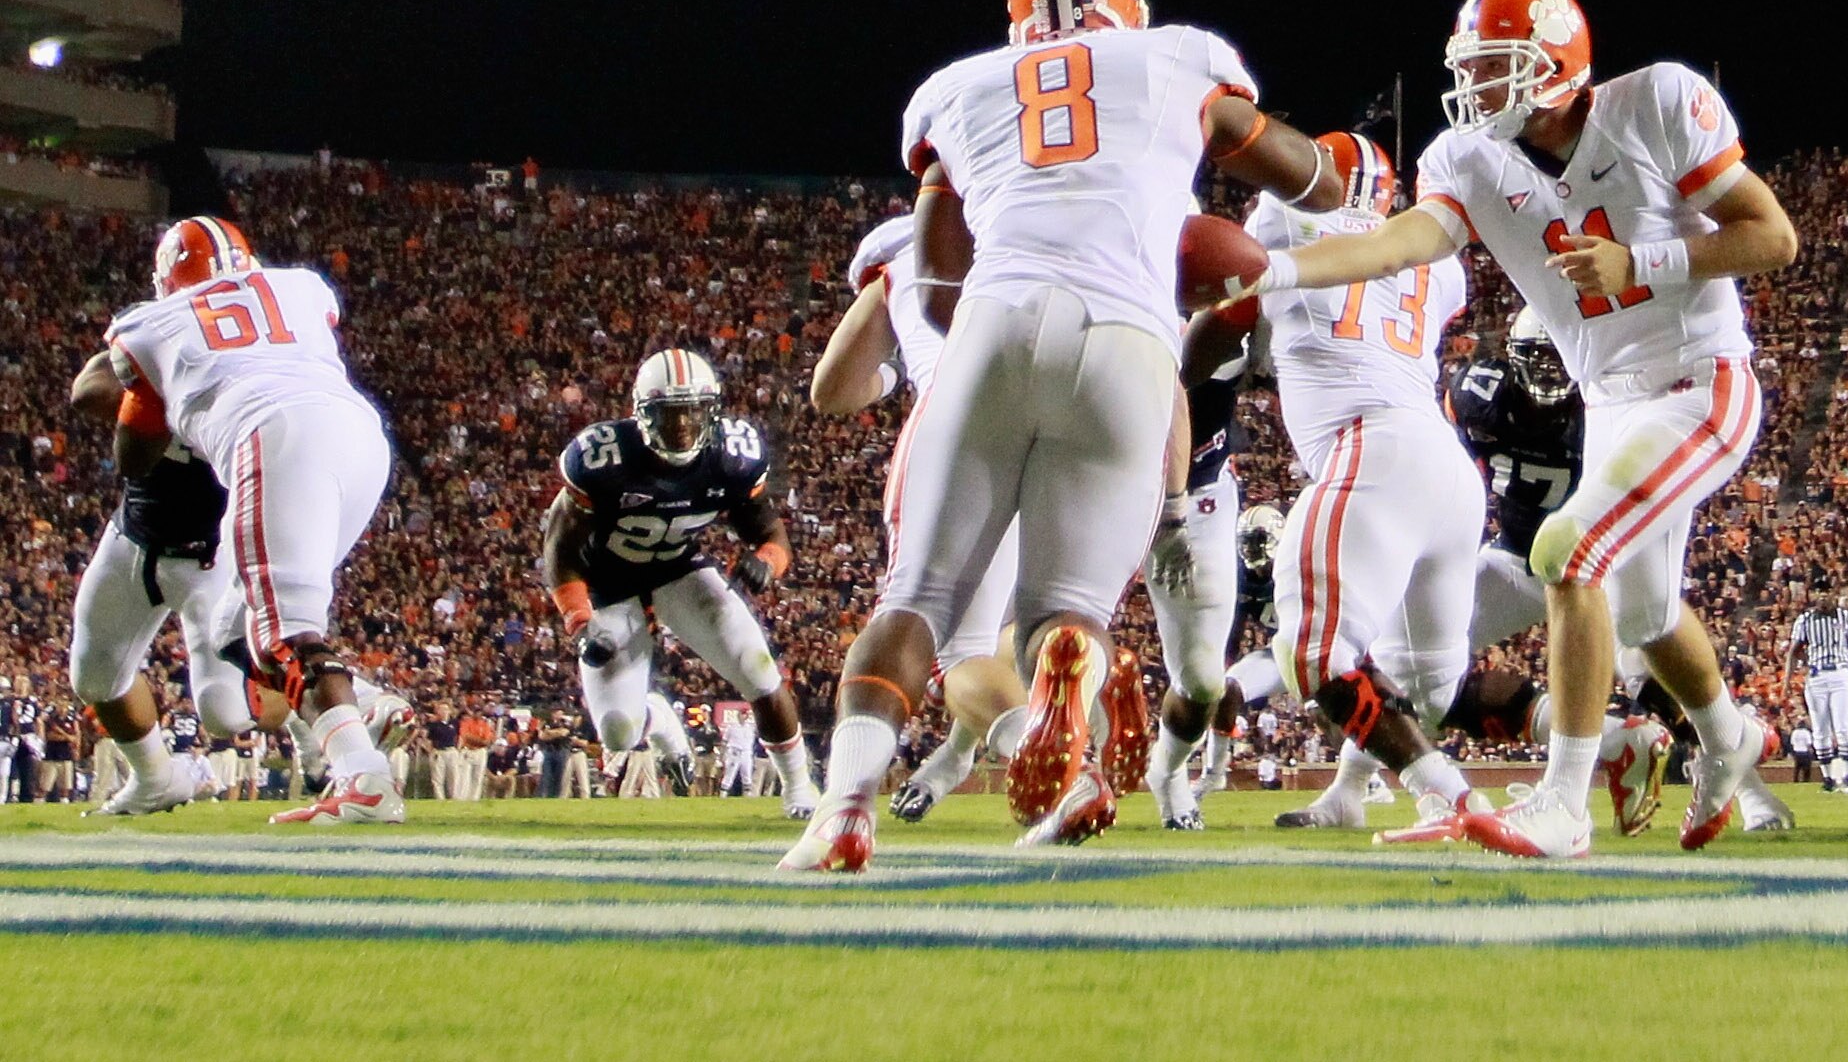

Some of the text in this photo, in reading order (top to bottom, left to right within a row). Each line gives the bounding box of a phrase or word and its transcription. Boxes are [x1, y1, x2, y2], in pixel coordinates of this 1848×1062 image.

[1073, 7, 1084, 21] 8
[1014, 42, 1099, 169] 8
[189, 272, 297, 351] 61
[576, 425, 623, 470] 25
[1489, 452, 1572, 508] 17
[605, 509, 720, 563] 25
